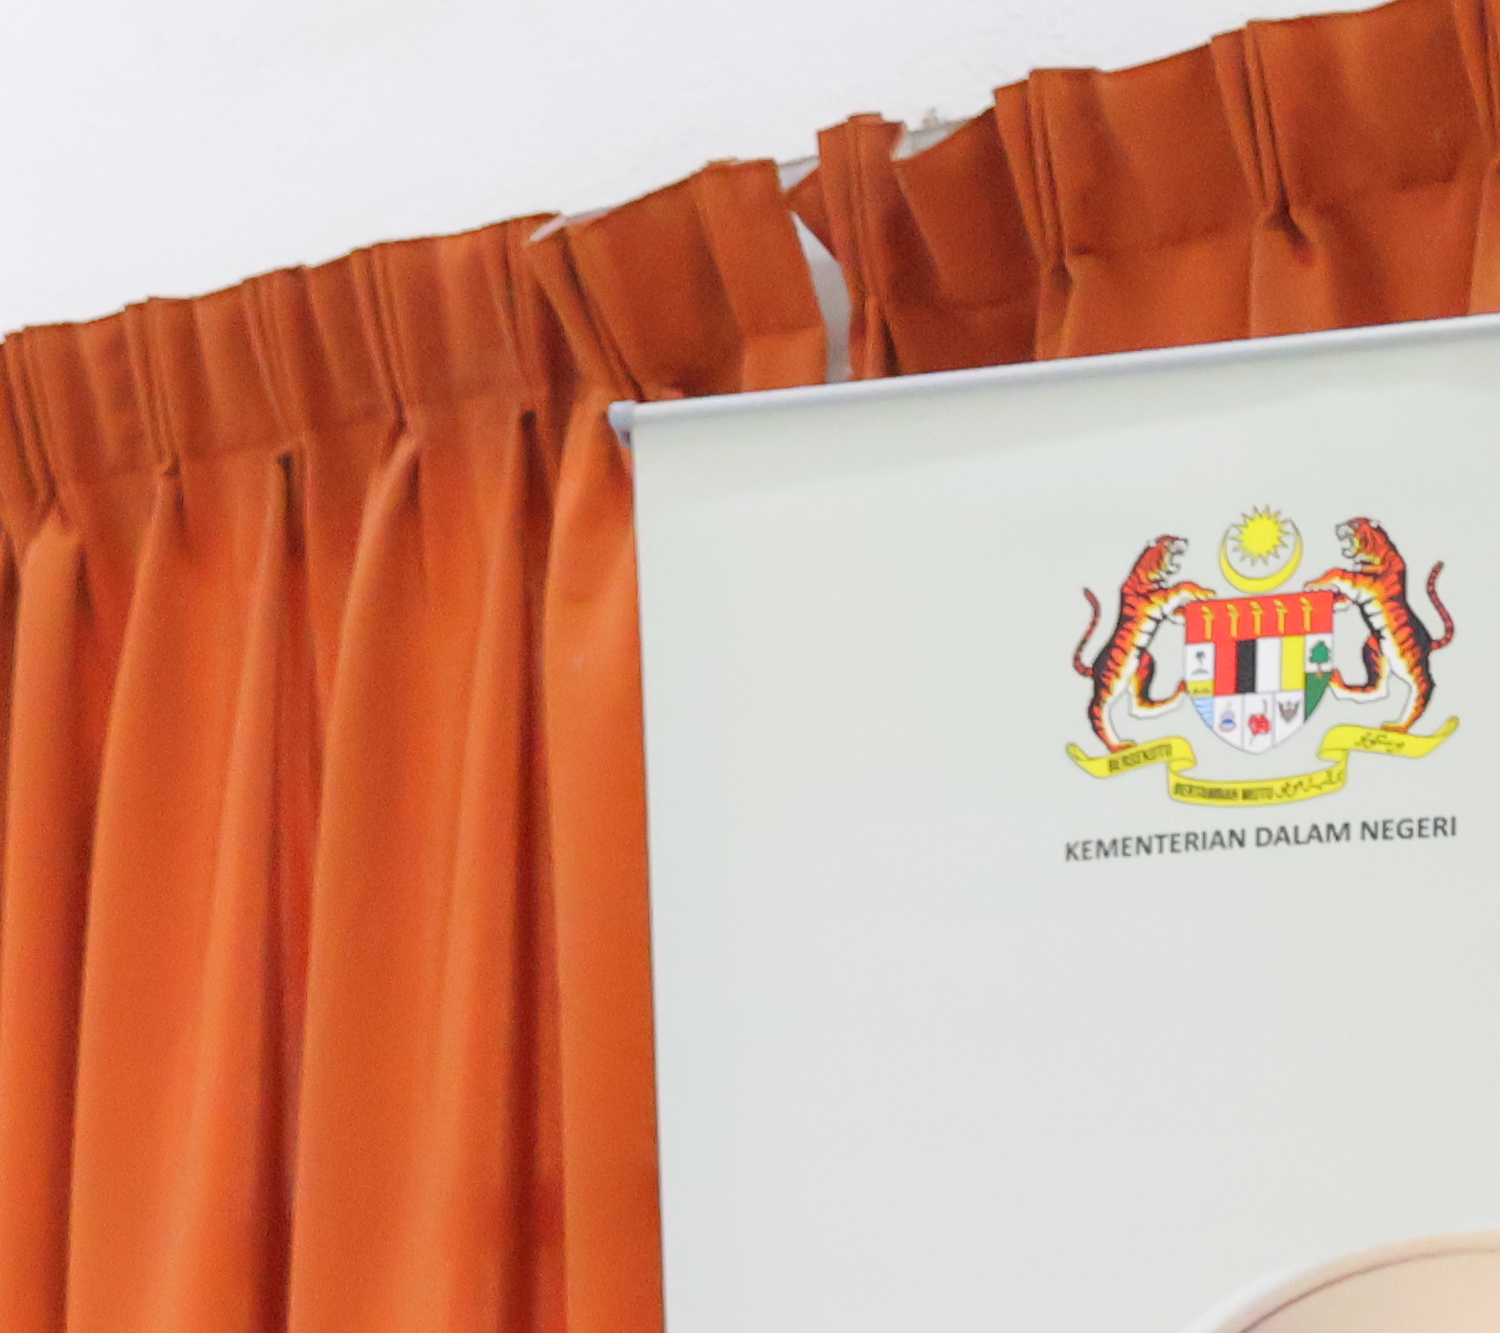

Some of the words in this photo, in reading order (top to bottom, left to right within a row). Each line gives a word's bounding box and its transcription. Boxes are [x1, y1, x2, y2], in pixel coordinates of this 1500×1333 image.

[1065, 828, 1246, 862] KEMENTERIAN
[1255, 822, 1351, 846] DALAM
[1361, 816, 1457, 841] NEGERI
